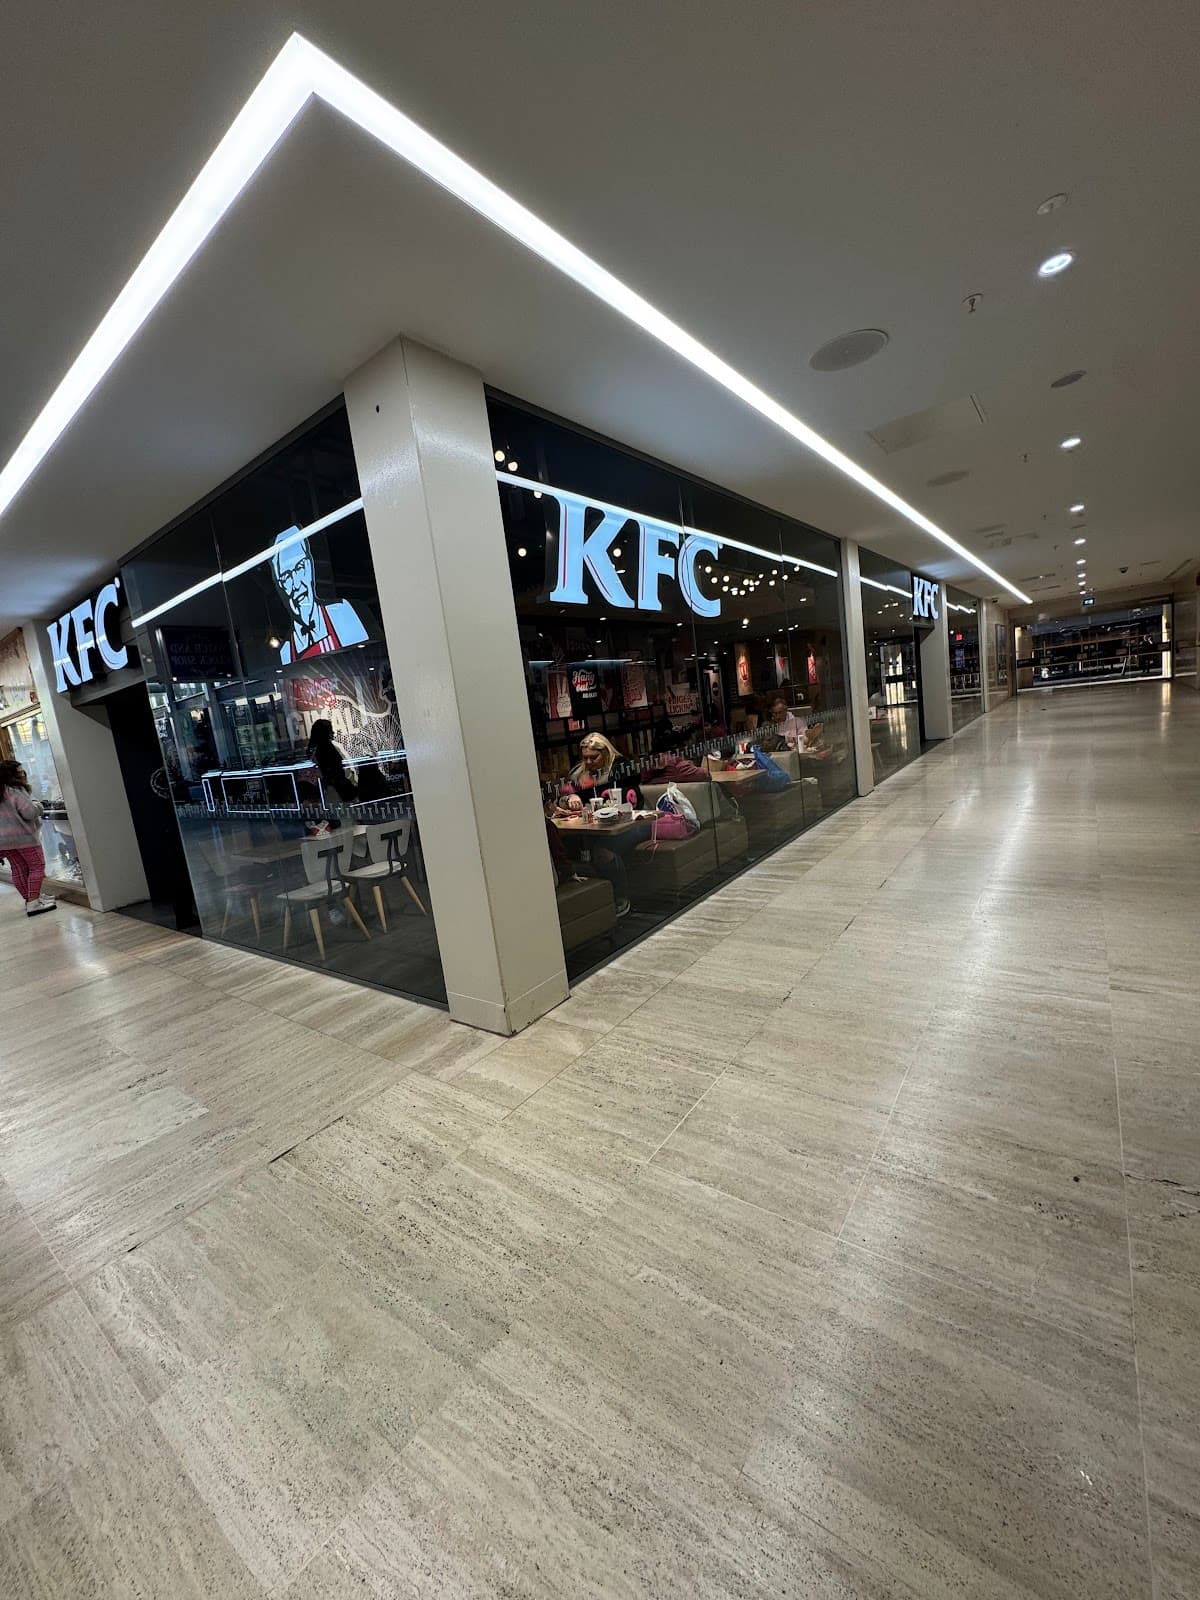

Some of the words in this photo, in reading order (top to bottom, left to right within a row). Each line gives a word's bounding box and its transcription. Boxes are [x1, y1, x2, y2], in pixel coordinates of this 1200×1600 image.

[549, 494, 721, 618] KFC
[913, 576, 939, 620] KFC
[46, 582, 128, 693] KFC
